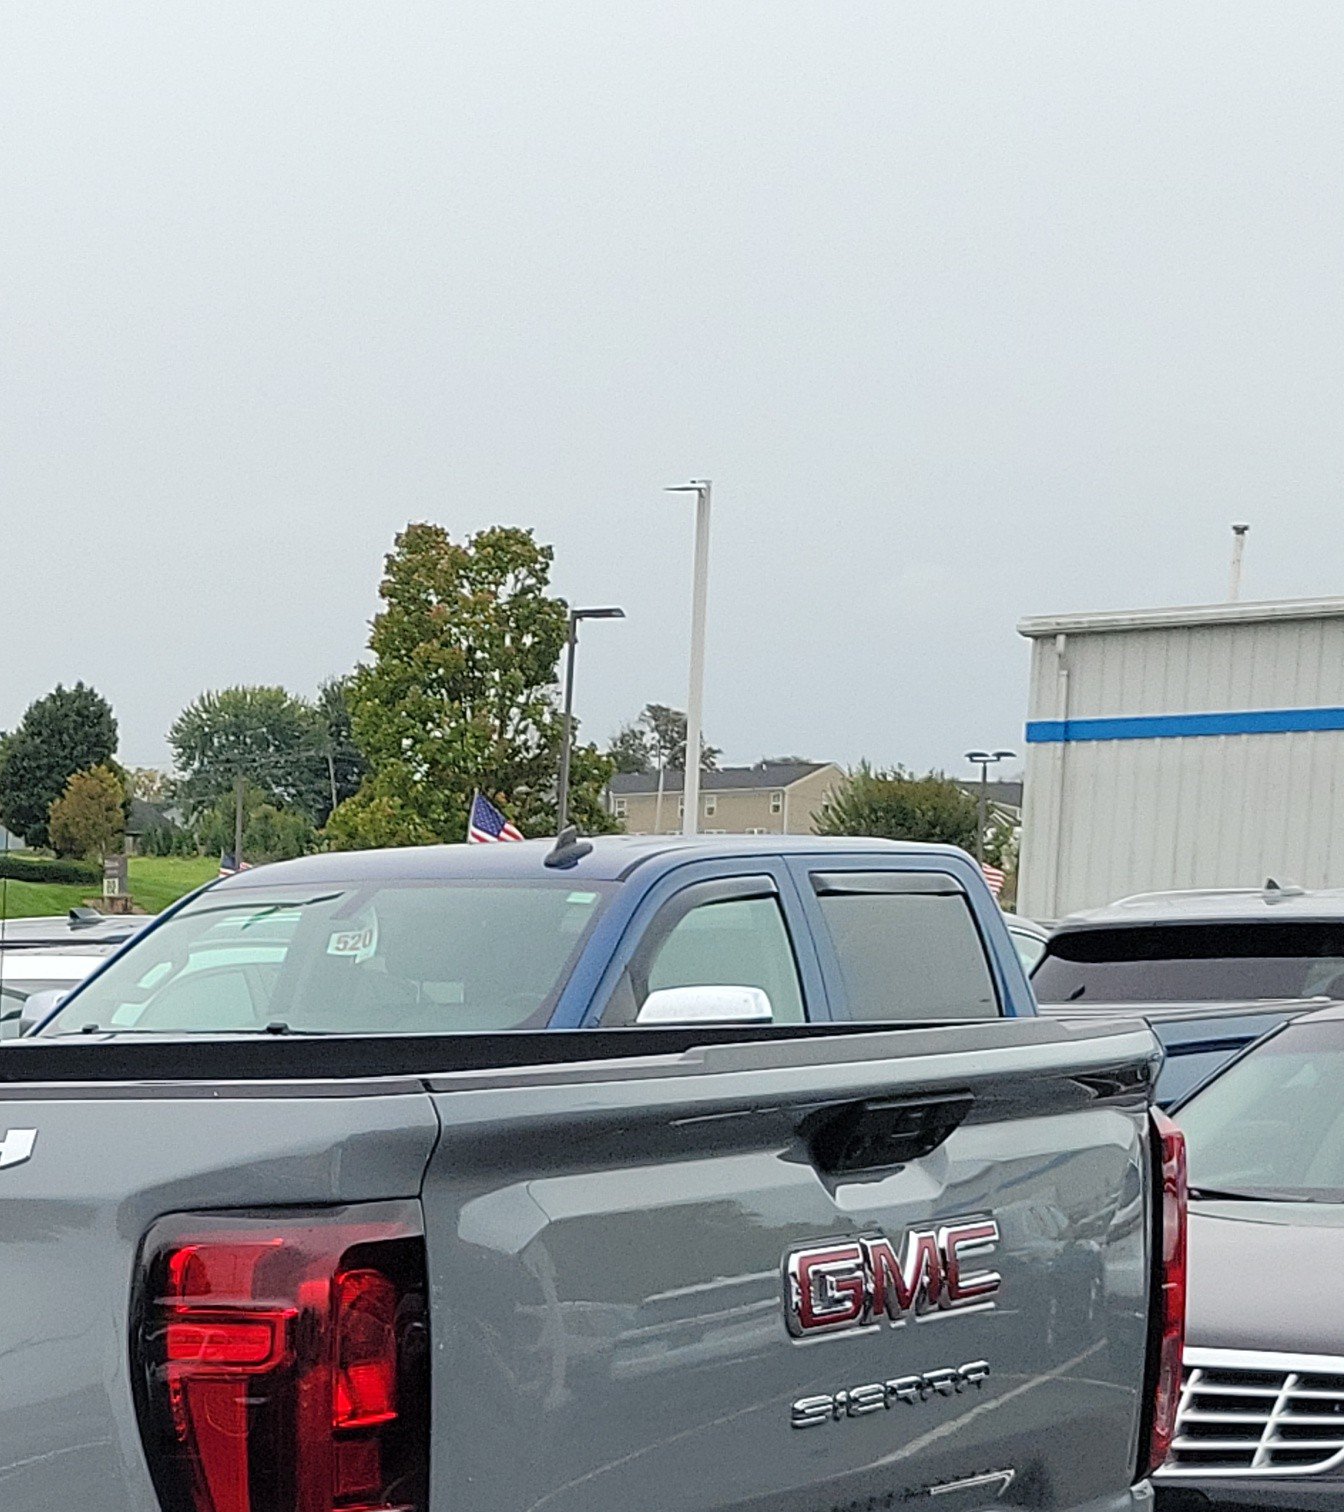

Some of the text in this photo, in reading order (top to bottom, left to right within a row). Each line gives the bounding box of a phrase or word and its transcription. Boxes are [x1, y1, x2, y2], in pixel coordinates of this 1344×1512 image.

[335, 929, 373, 951] 520
[785, 1217, 1003, 1338] GMC
[791, 1359, 991, 1430] SIERRA
